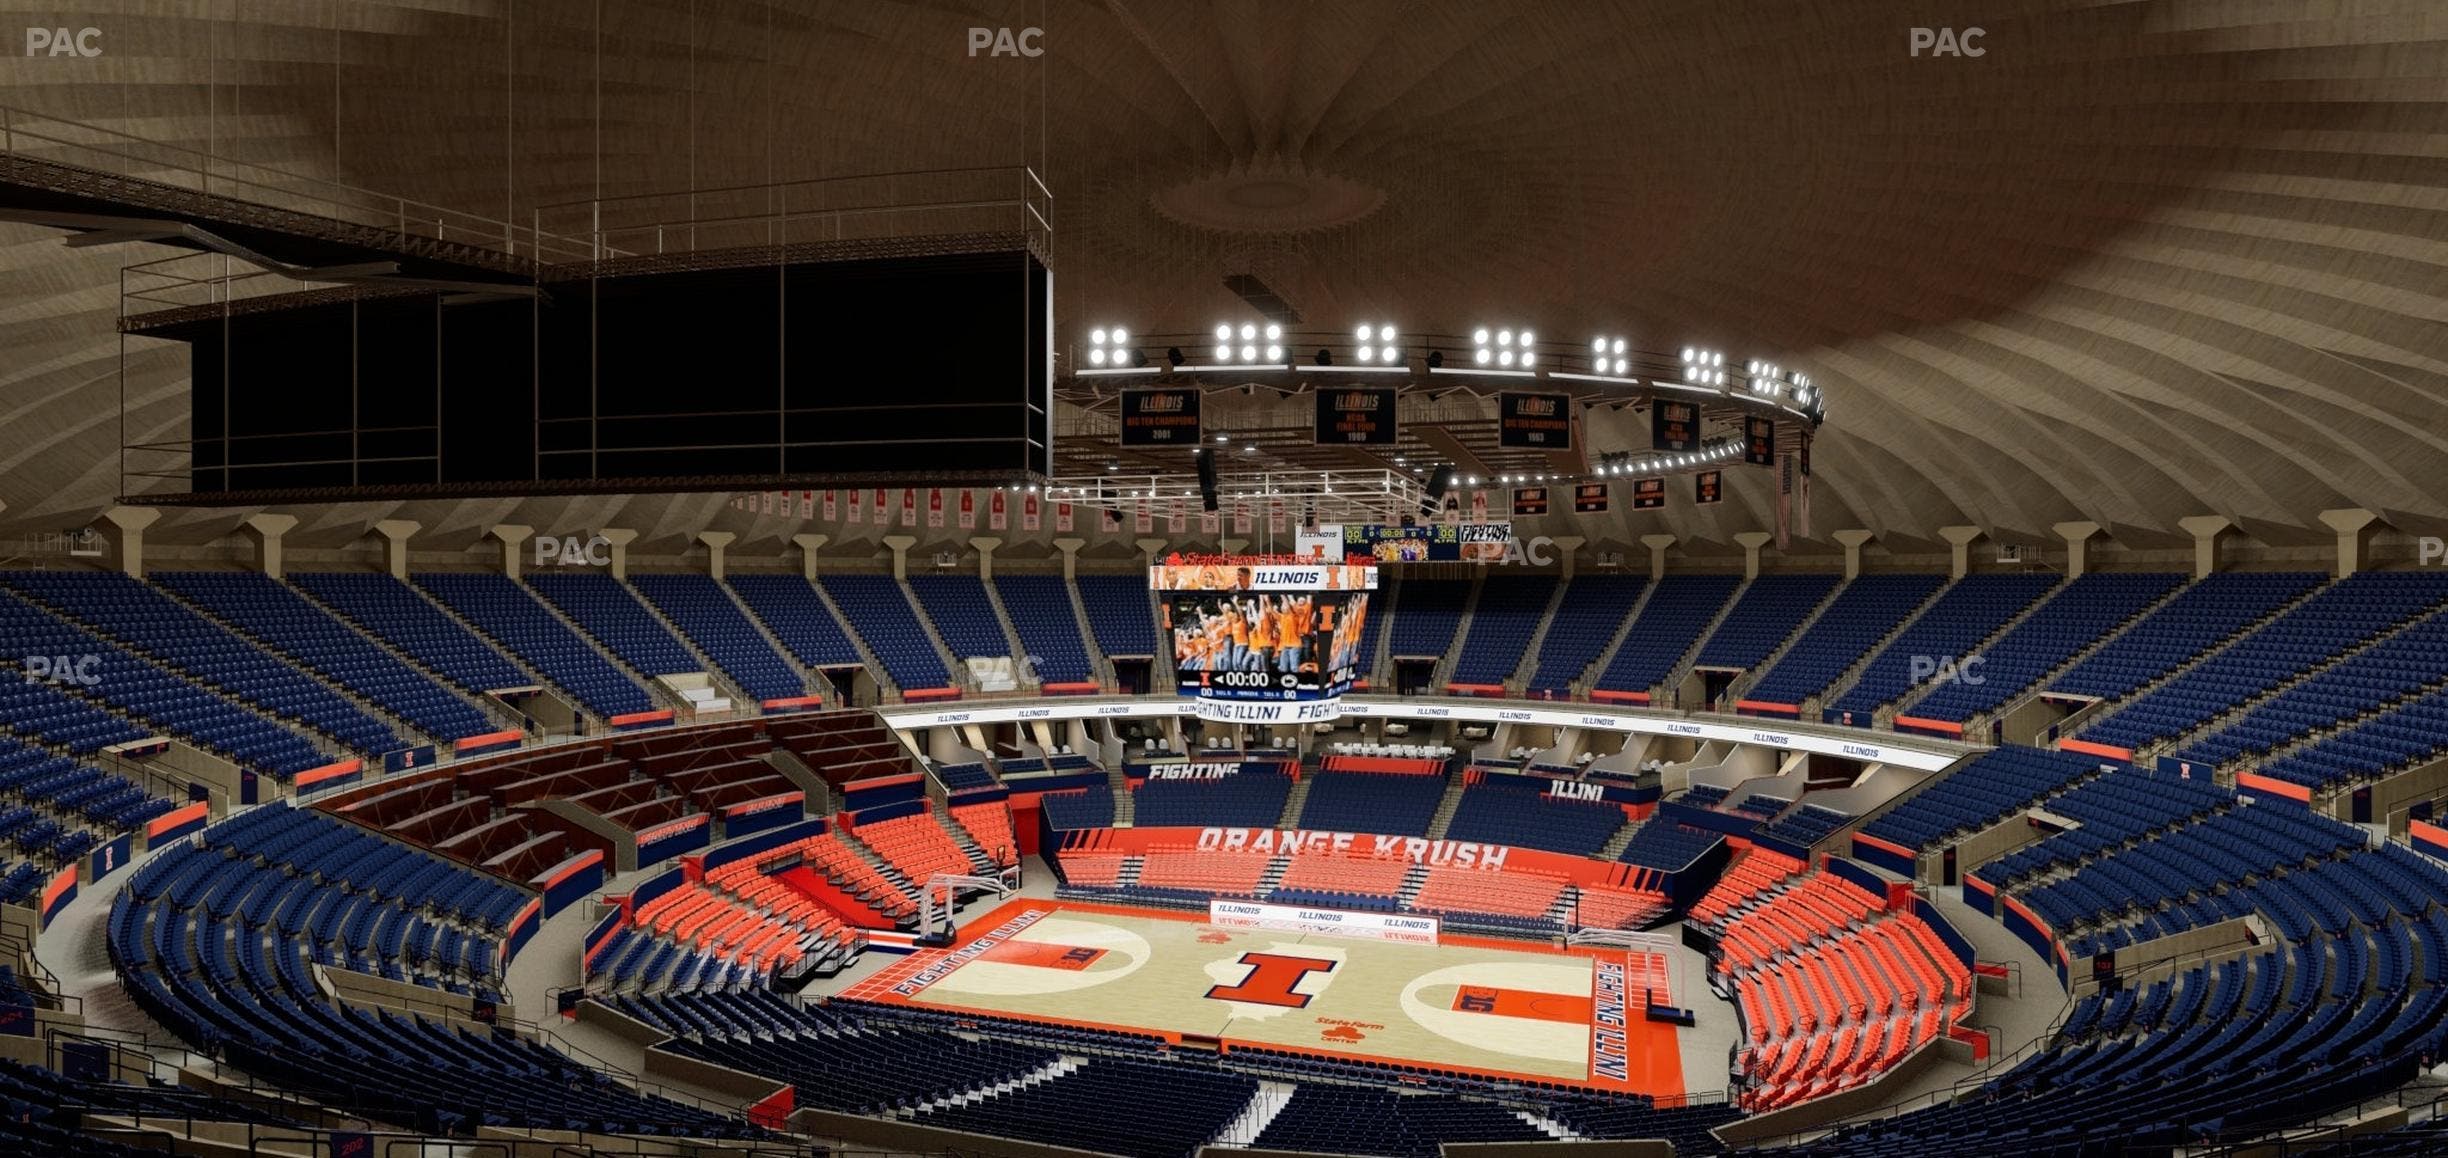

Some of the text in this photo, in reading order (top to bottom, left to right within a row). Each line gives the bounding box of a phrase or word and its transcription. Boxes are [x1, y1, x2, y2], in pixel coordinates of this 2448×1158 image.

[1139, 395, 1184, 410] ILLINOIS
[1335, 394, 1379, 409] ILLINOIS
[1517, 398, 1556, 414] ILLINOIS
[1152, 429, 1171, 439] 2001
[1254, 572, 1319, 584] ILLINOIS
[1226, 671, 1269, 687] 00:00
[1201, 687, 1213, 696] 00
[1284, 689, 1296, 699] 00
[1018, 709, 1050, 718] ILLINOIS
[1098, 706, 1130, 715] ILLINOIS
[1235, 705, 1281, 720] ILLINI
[1417, 708, 1449, 717] ILLINOIS
[1499, 712, 1532, 720] ILLINOIS
[937, 713, 970, 722] ILLINOIS
[1582, 717, 1615, 727] ILLINOIS
[1667, 723, 1701, 735] ILLINOIS
[1753, 732, 1789, 745] ILLINOIS
[1842, 744, 1879, 758] ILLINOIS
[1550, 779, 1604, 802] ILLINI
[1197, 826, 1509, 871] ORANGE KRUSH
[1218, 903, 1261, 916] ILLINOIS
[1298, 911, 1343, 923] ILLINOIS
[1384, 918, 1431, 930] ILLINOIS
[892, 938, 998, 995] FIGHTING
[1594, 960, 1628, 1082] FIGHTING ILLINI
